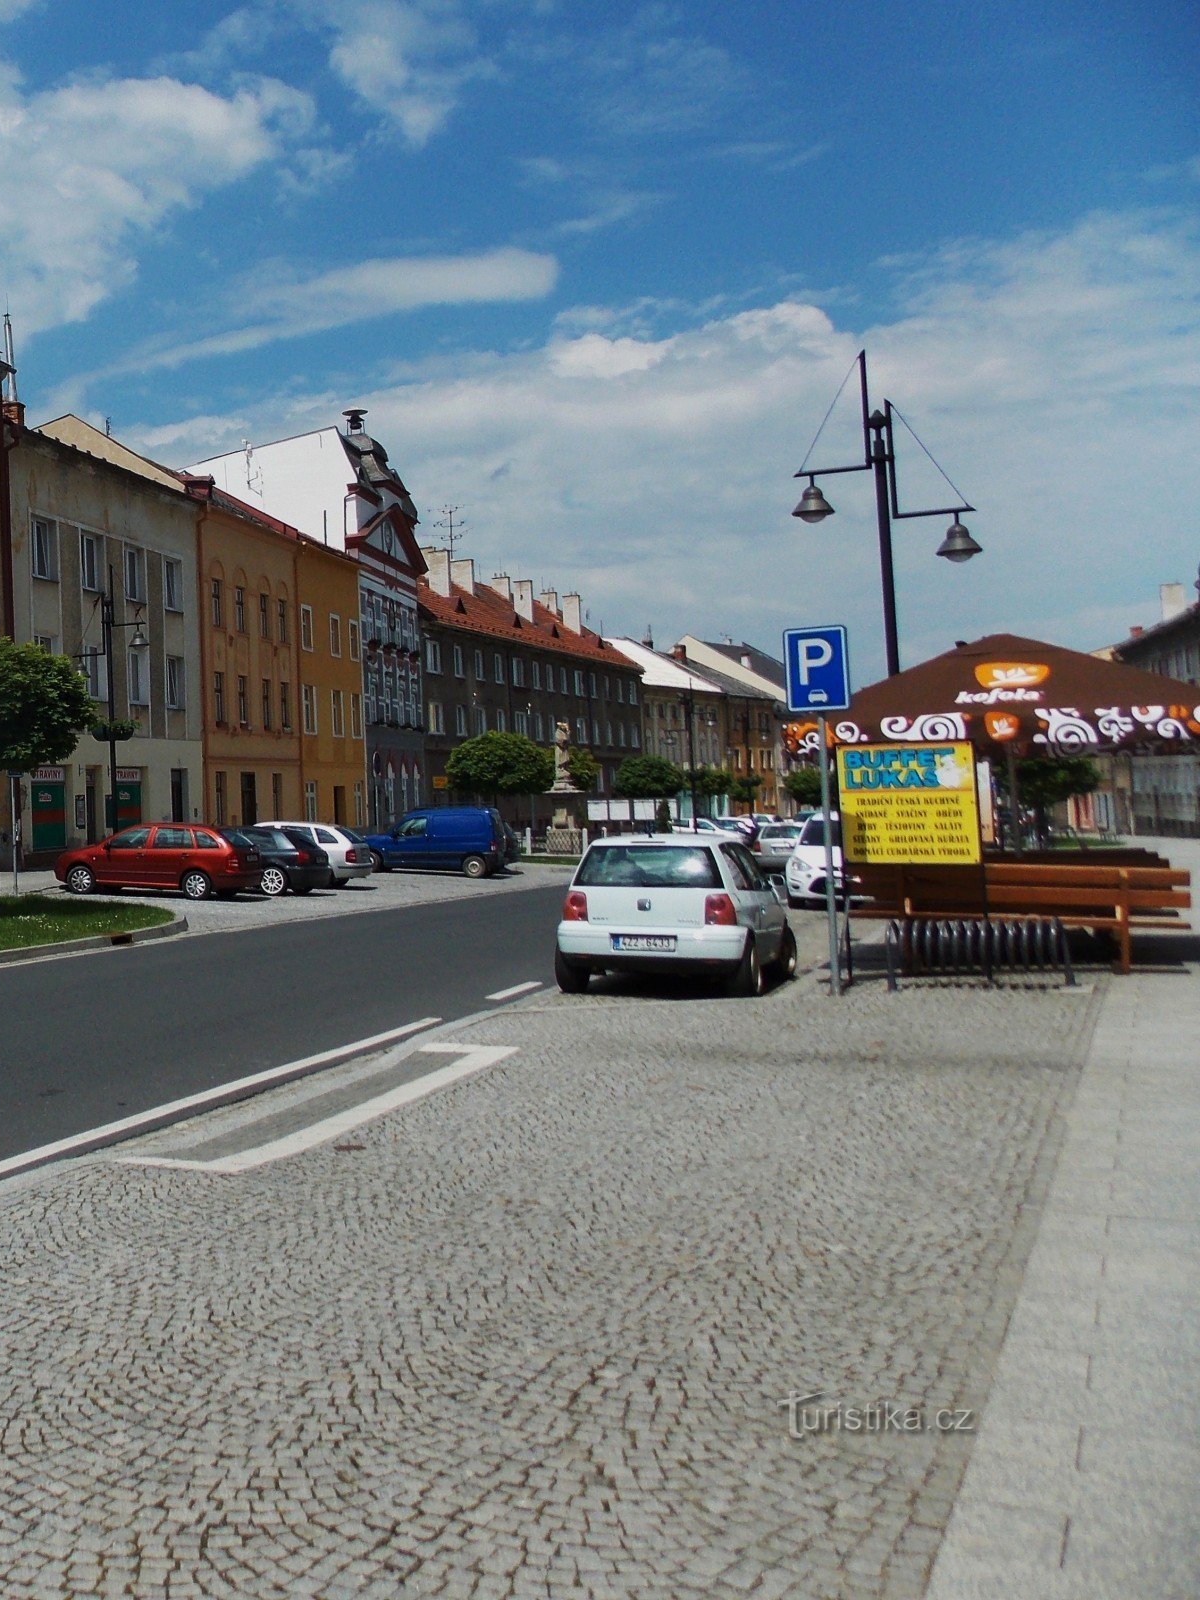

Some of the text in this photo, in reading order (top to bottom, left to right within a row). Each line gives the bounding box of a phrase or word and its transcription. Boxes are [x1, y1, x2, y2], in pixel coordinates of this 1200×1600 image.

[797, 638, 832, 686] P
[844, 747, 955, 769] BUFFET
[646, 937, 671, 948] 6433
